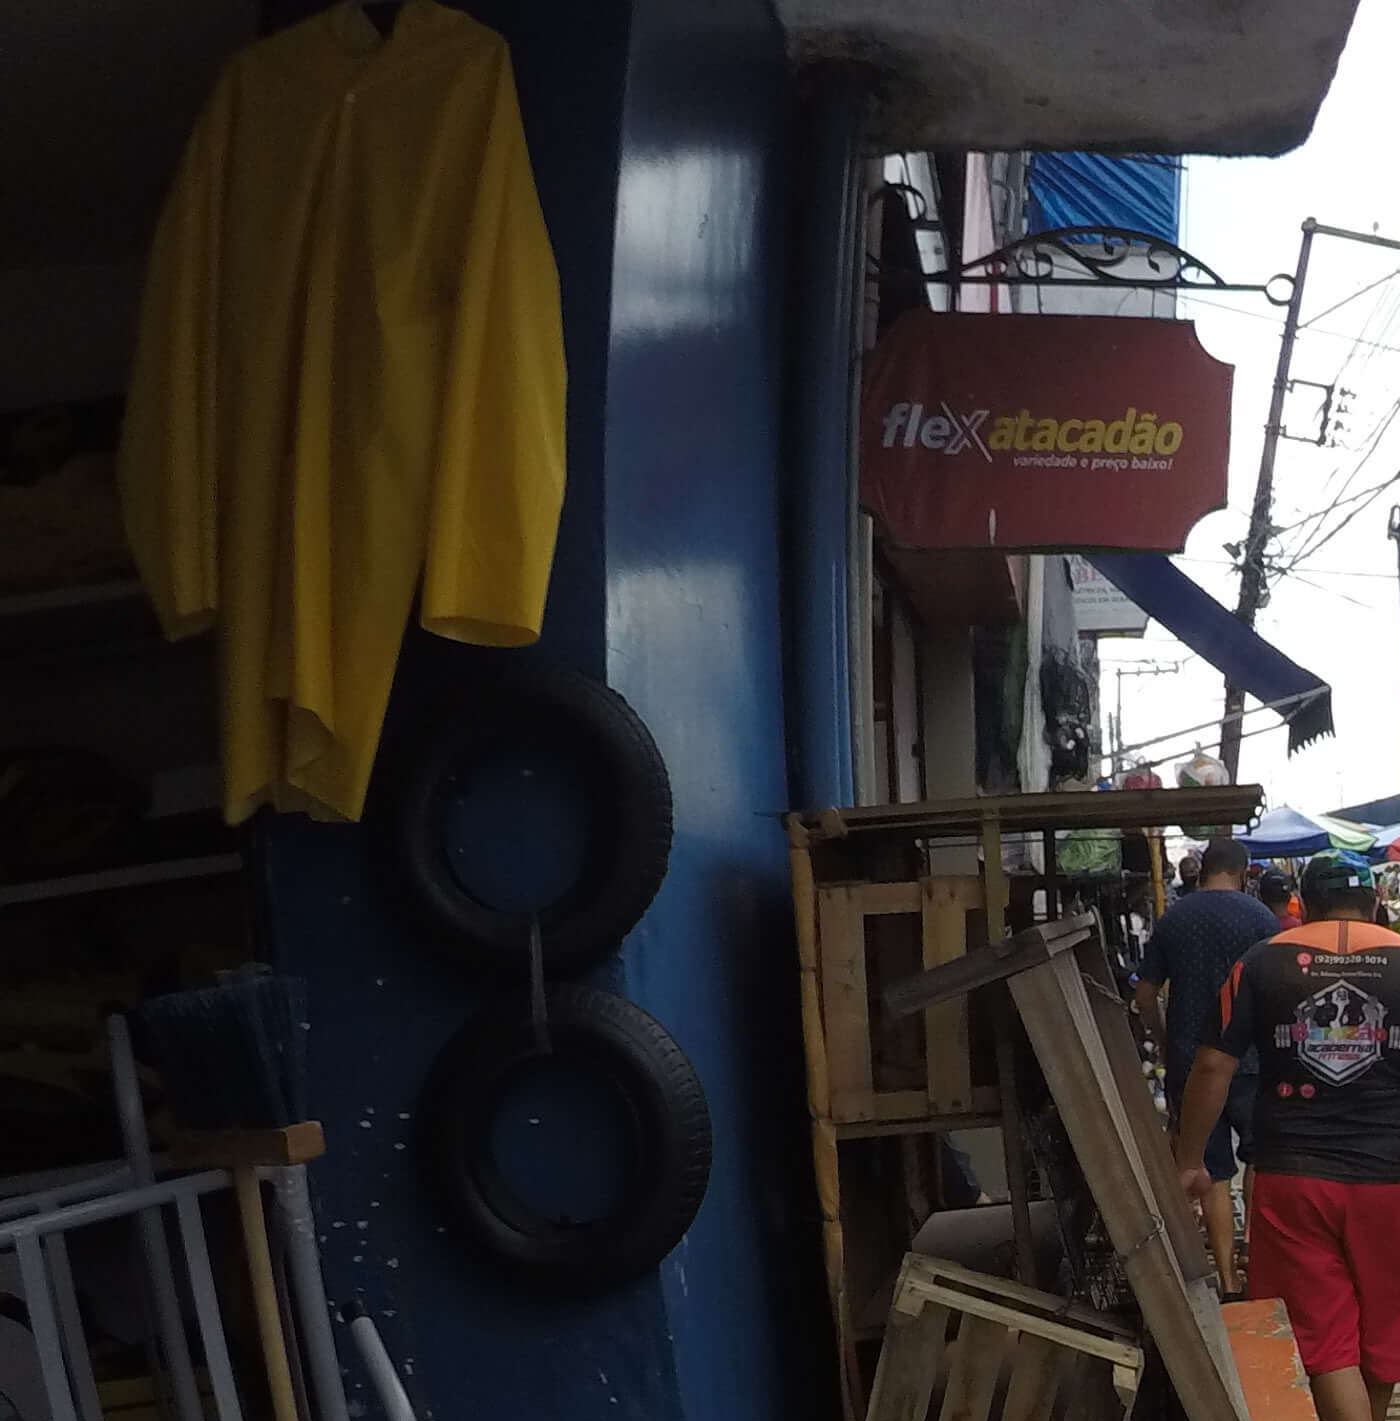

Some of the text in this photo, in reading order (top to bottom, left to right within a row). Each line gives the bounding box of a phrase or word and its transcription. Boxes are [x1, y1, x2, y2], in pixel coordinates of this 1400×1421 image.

[988, 407, 1184, 456] atacadão
[1013, 454, 1078, 468] variedade
[1091, 457, 1128, 472] preço
[1131, 457, 1173, 470] baixo!
